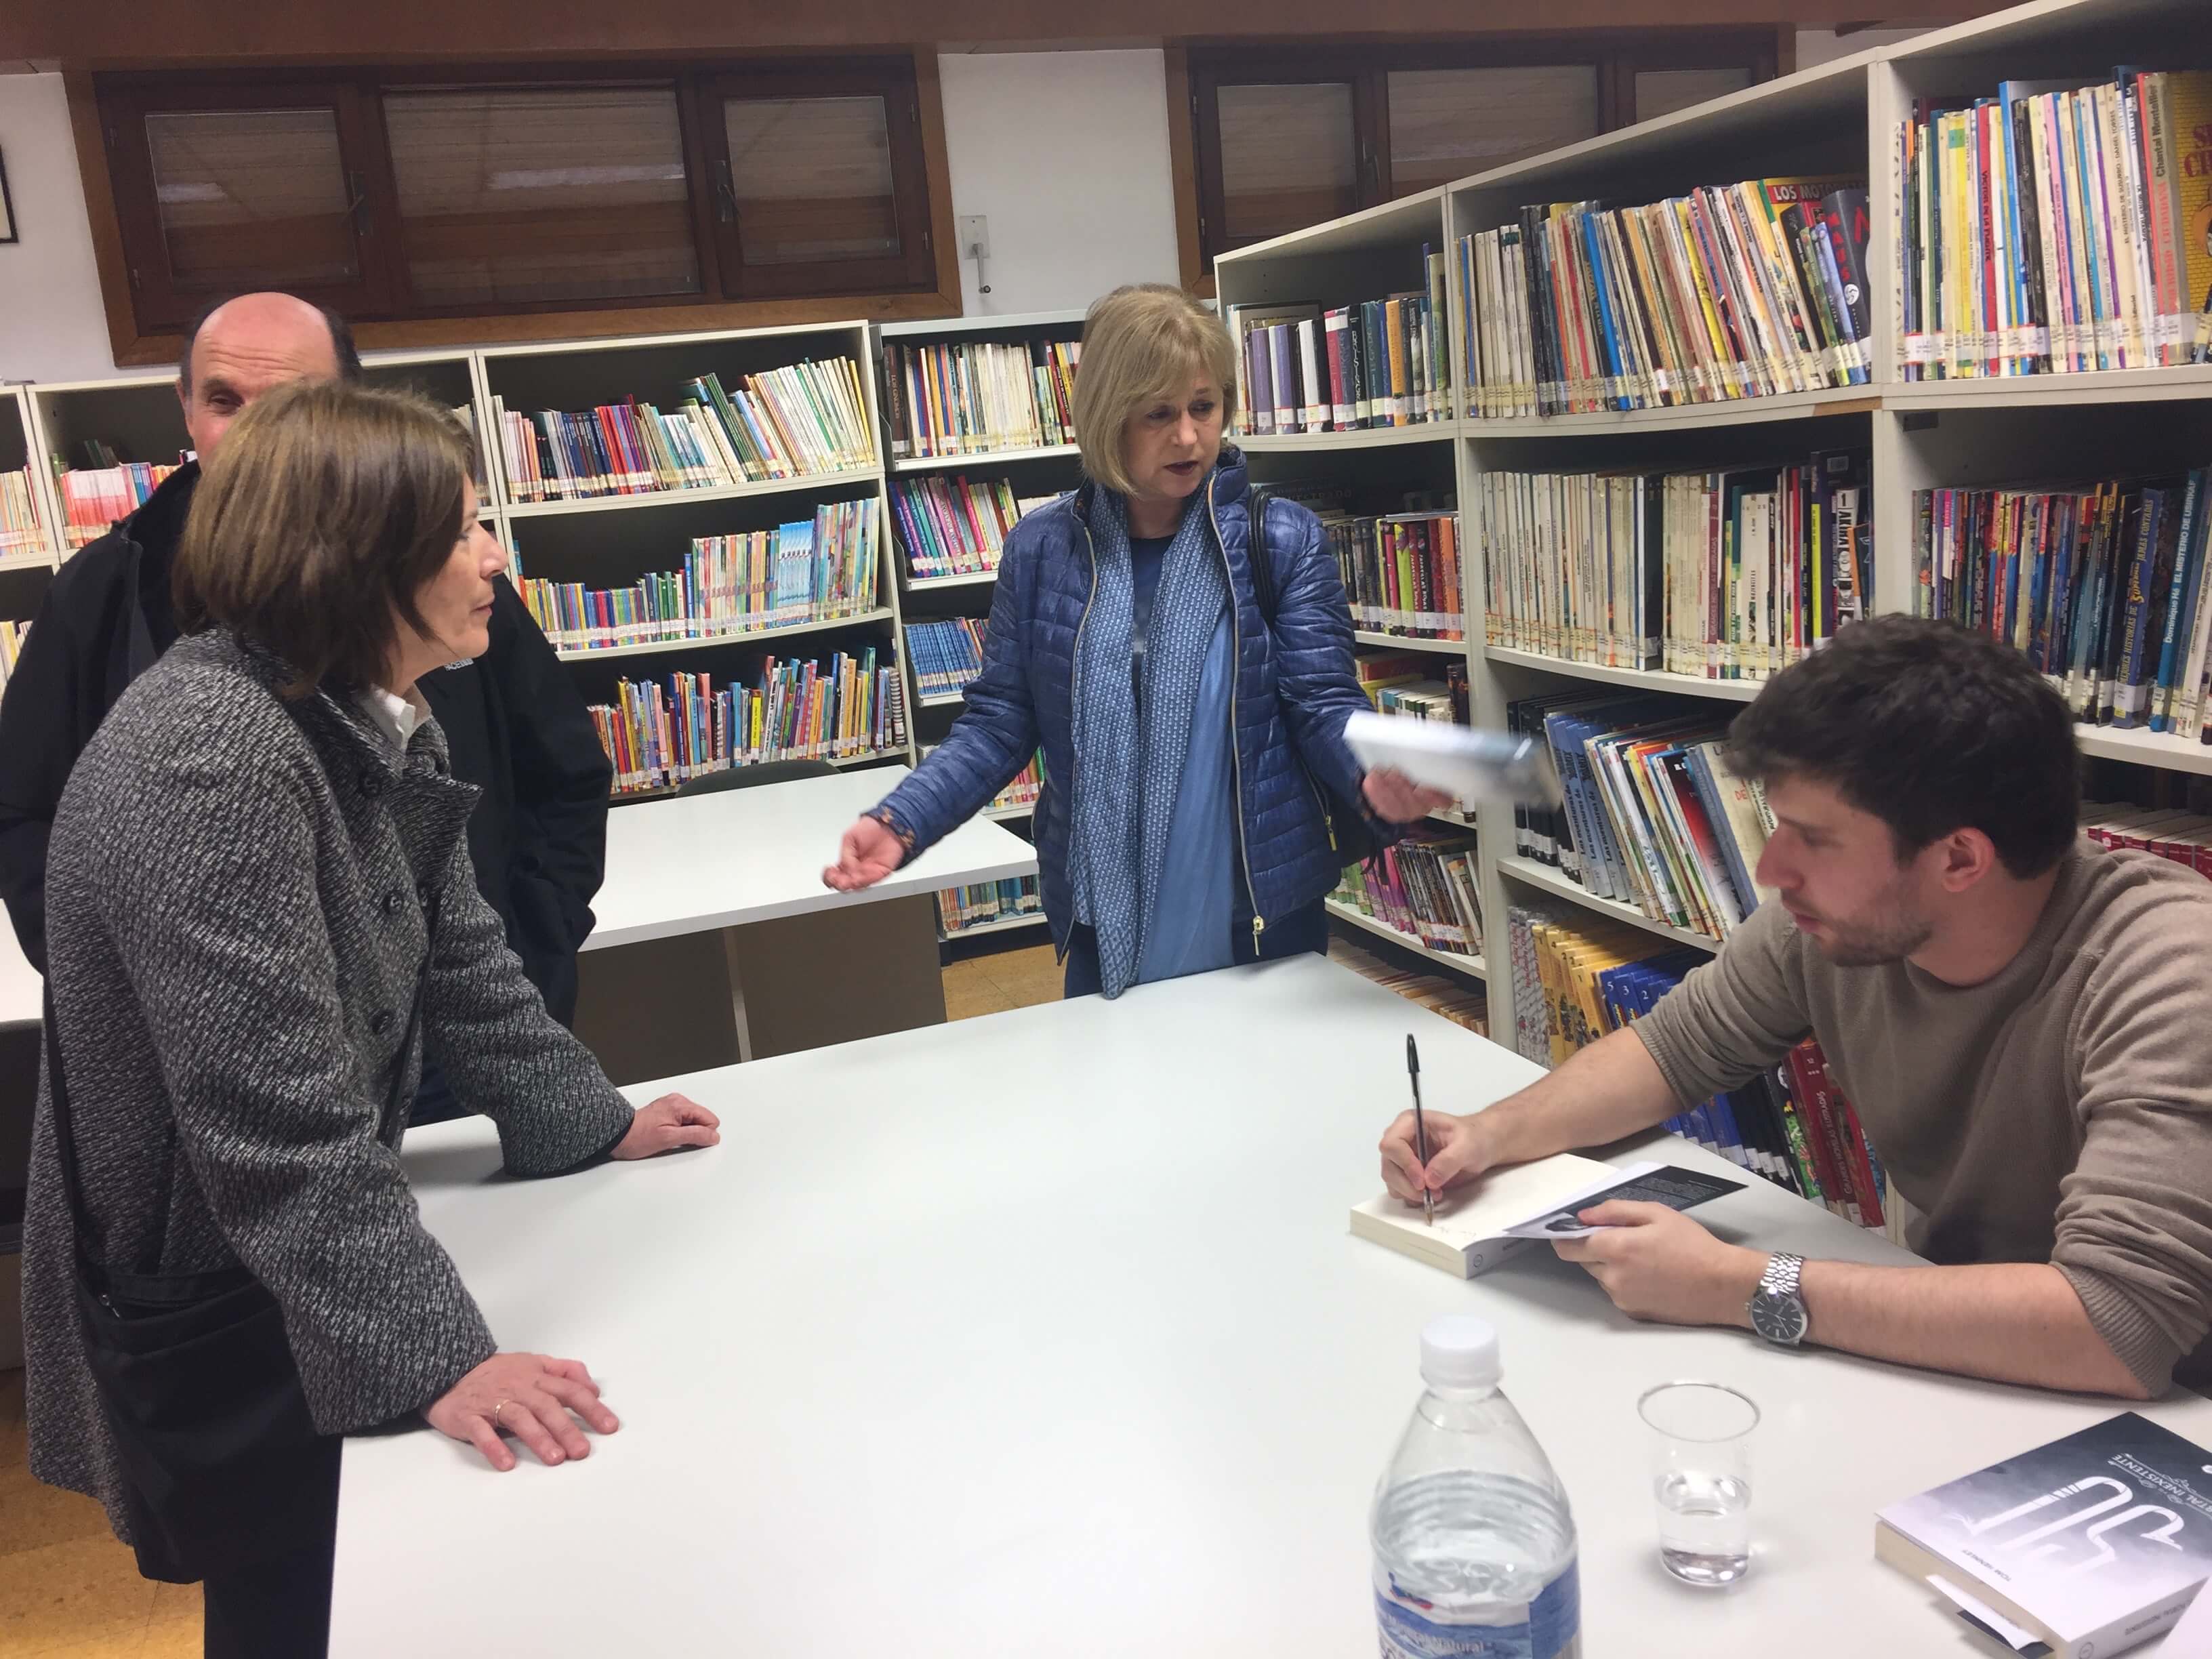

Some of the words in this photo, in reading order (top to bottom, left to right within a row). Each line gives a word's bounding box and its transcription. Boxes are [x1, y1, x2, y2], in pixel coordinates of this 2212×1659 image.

[2109, 108, 2118, 134] TORRES
[2155, 138, 2165, 177] Chantal
[1773, 186, 1797, 201] LOS
[2118, 194, 2125, 203] DE
[2120, 205, 2129, 235] MISTERIO
[1841, 493, 1847, 507] 1
[1839, 510, 1851, 547] AKIRA
[2141, 498, 2154, 536] CONTADAS
[2181, 518, 2190, 529] DE
[2175, 531, 2188, 571] MISTERIO
[2173, 572, 2182, 583] EL
[2129, 605, 2138, 615] DE
[2164, 599, 2179, 643] Dominique
[2123, 617, 2137, 653] HISTORIAS
[1564, 784, 1571, 795] de
[1573, 787, 1580, 799] de
[1587, 790, 1595, 802] de
[1568, 796, 1582, 838] aventuras
[1577, 800, 1593, 843] aventuras
[1591, 802, 1607, 845] aventuras
[1578, 840, 1586, 855] Las
[1588, 844, 1597, 859] Las
[1603, 846, 1612, 861] Las
[1816, 1090, 1832, 1127] ILUSTRADAS
[1837, 1161, 1851, 1194] GRANDES
[2111, 1454, 2185, 1502] INEXISTENTE
